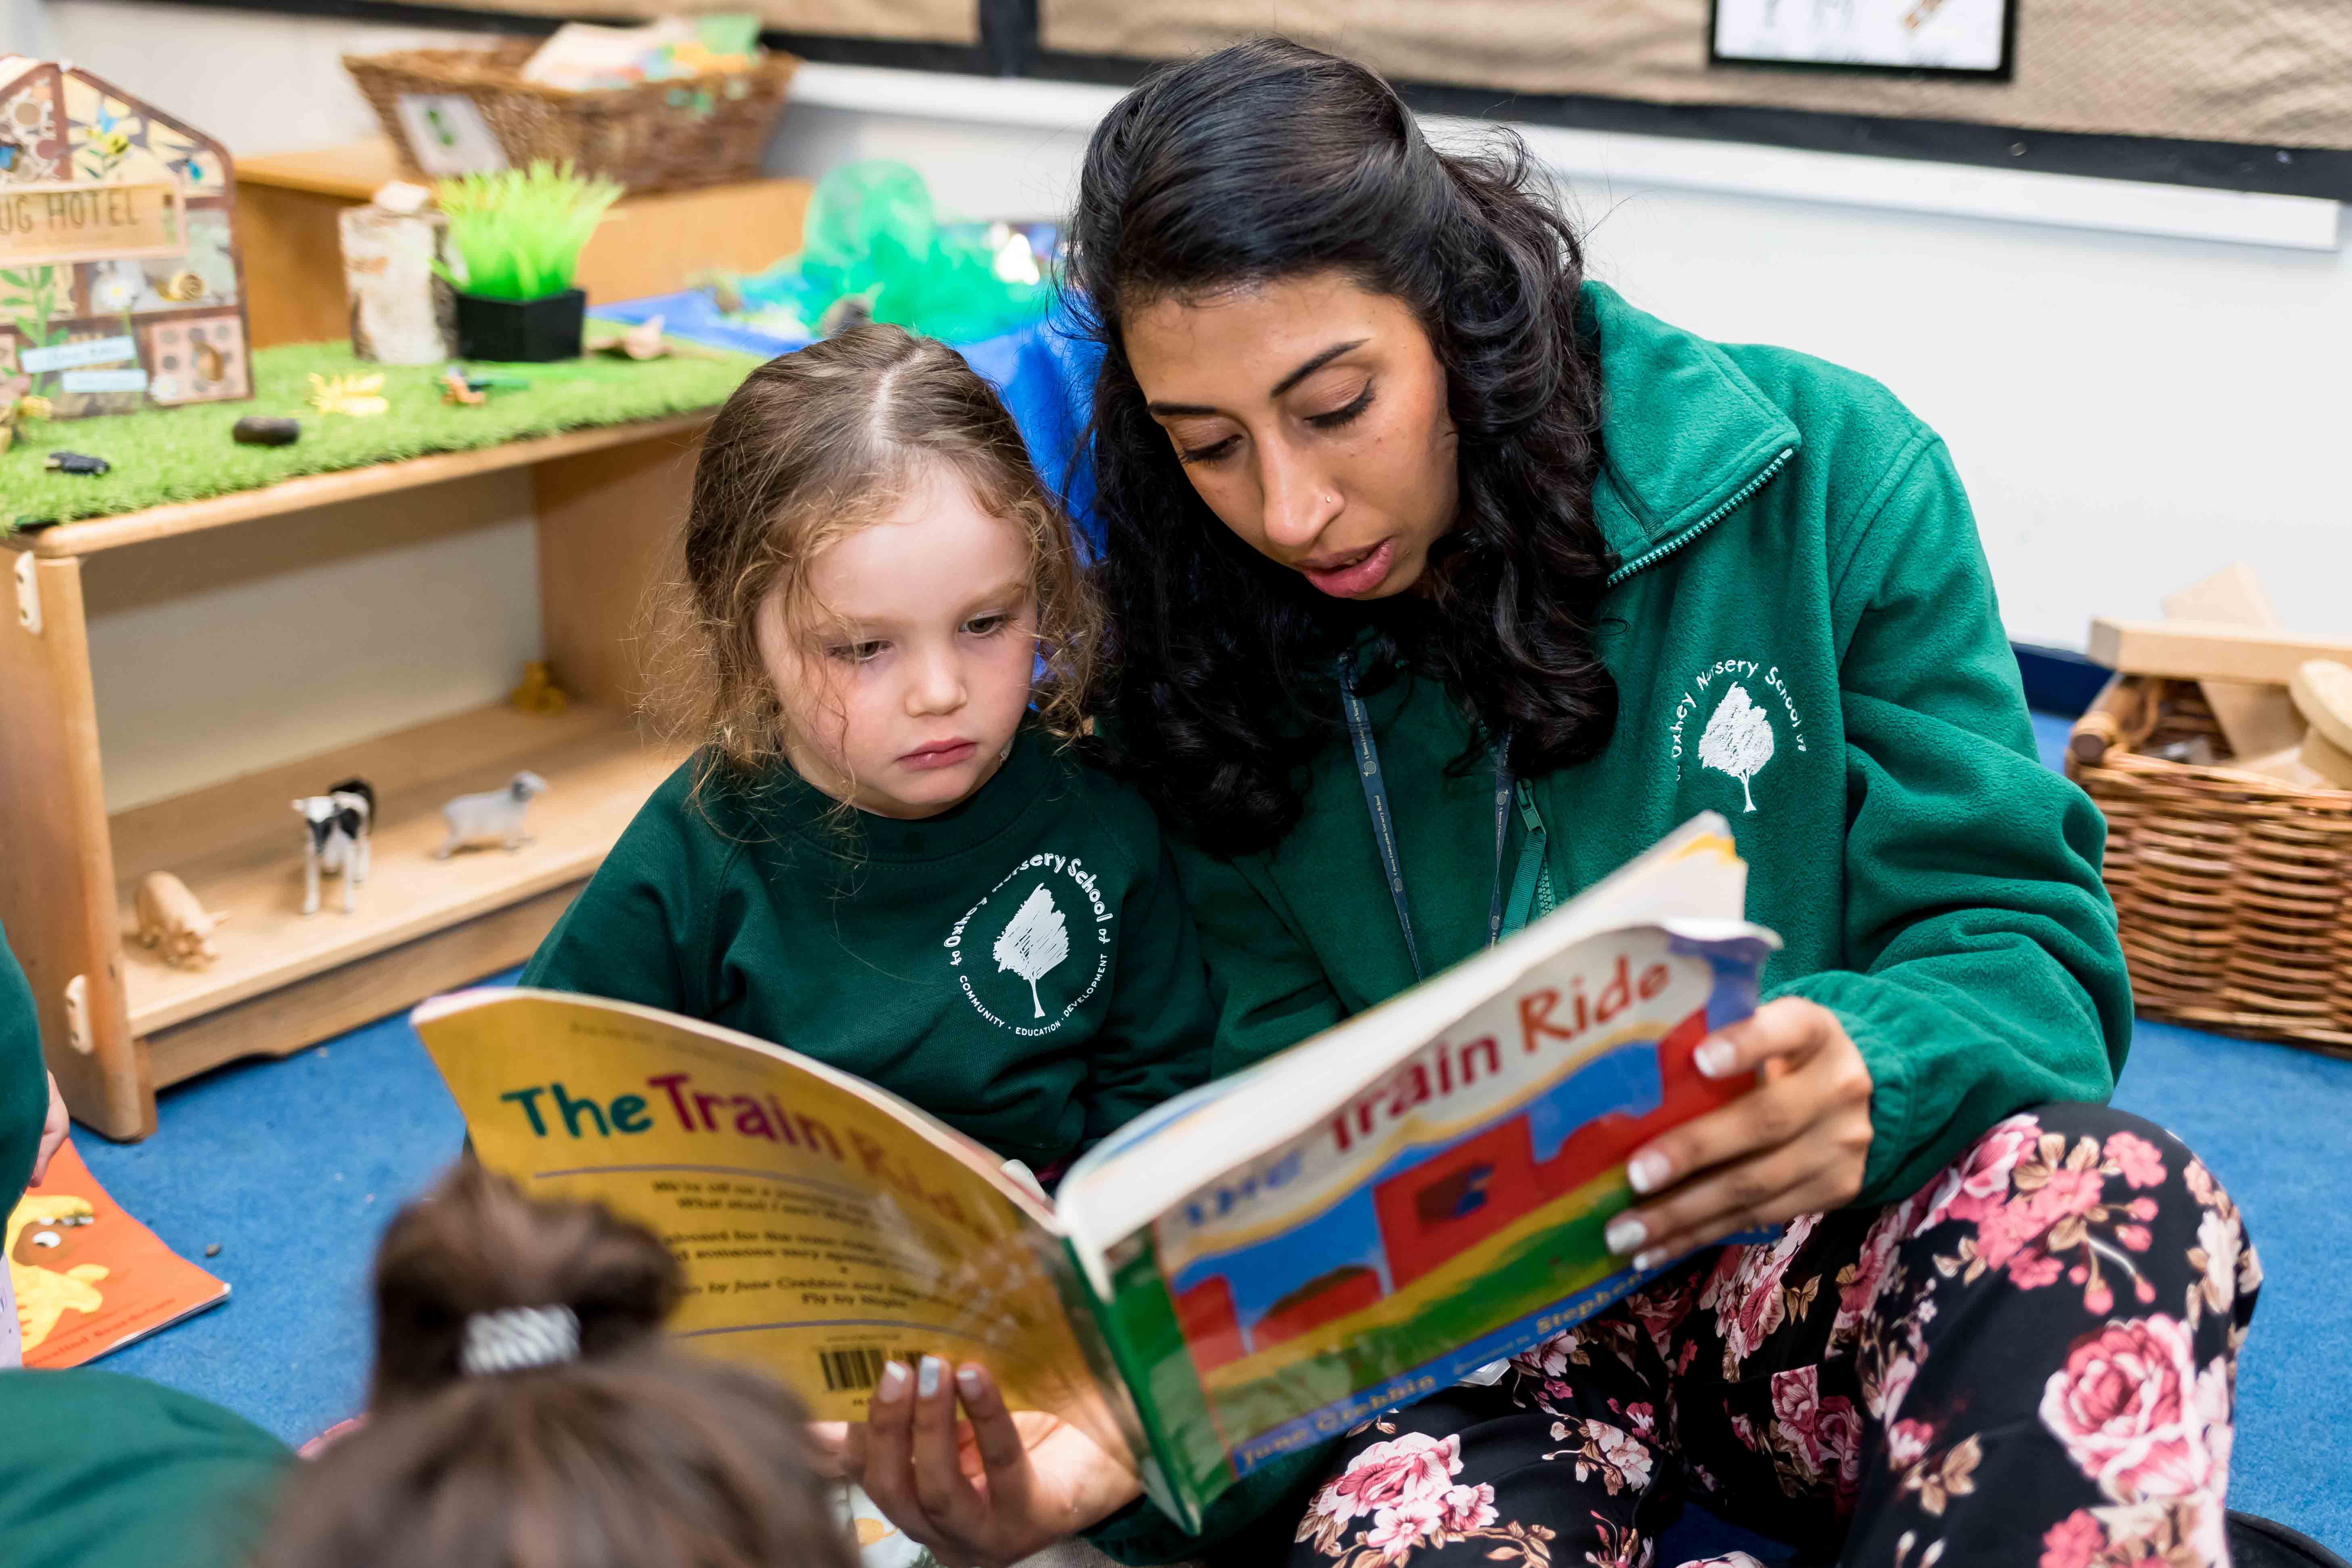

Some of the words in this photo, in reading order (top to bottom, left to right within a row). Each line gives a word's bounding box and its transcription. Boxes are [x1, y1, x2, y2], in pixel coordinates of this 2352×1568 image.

[47, 189, 138, 231] HOTEL
[1696, 659, 1759, 691] Nursery
[1765, 667, 1802, 728] School
[1067, 858, 1113, 922] School
[959, 975, 1005, 1028] COMMUNITY
[1015, 1020, 1061, 1036] EDUCATION
[1063, 954, 1107, 1017] DEVELOPMENT
[1518, 951, 1670, 1053] Ride
[500, 1082, 653, 1138] The
[647, 1073, 845, 1162] Train
